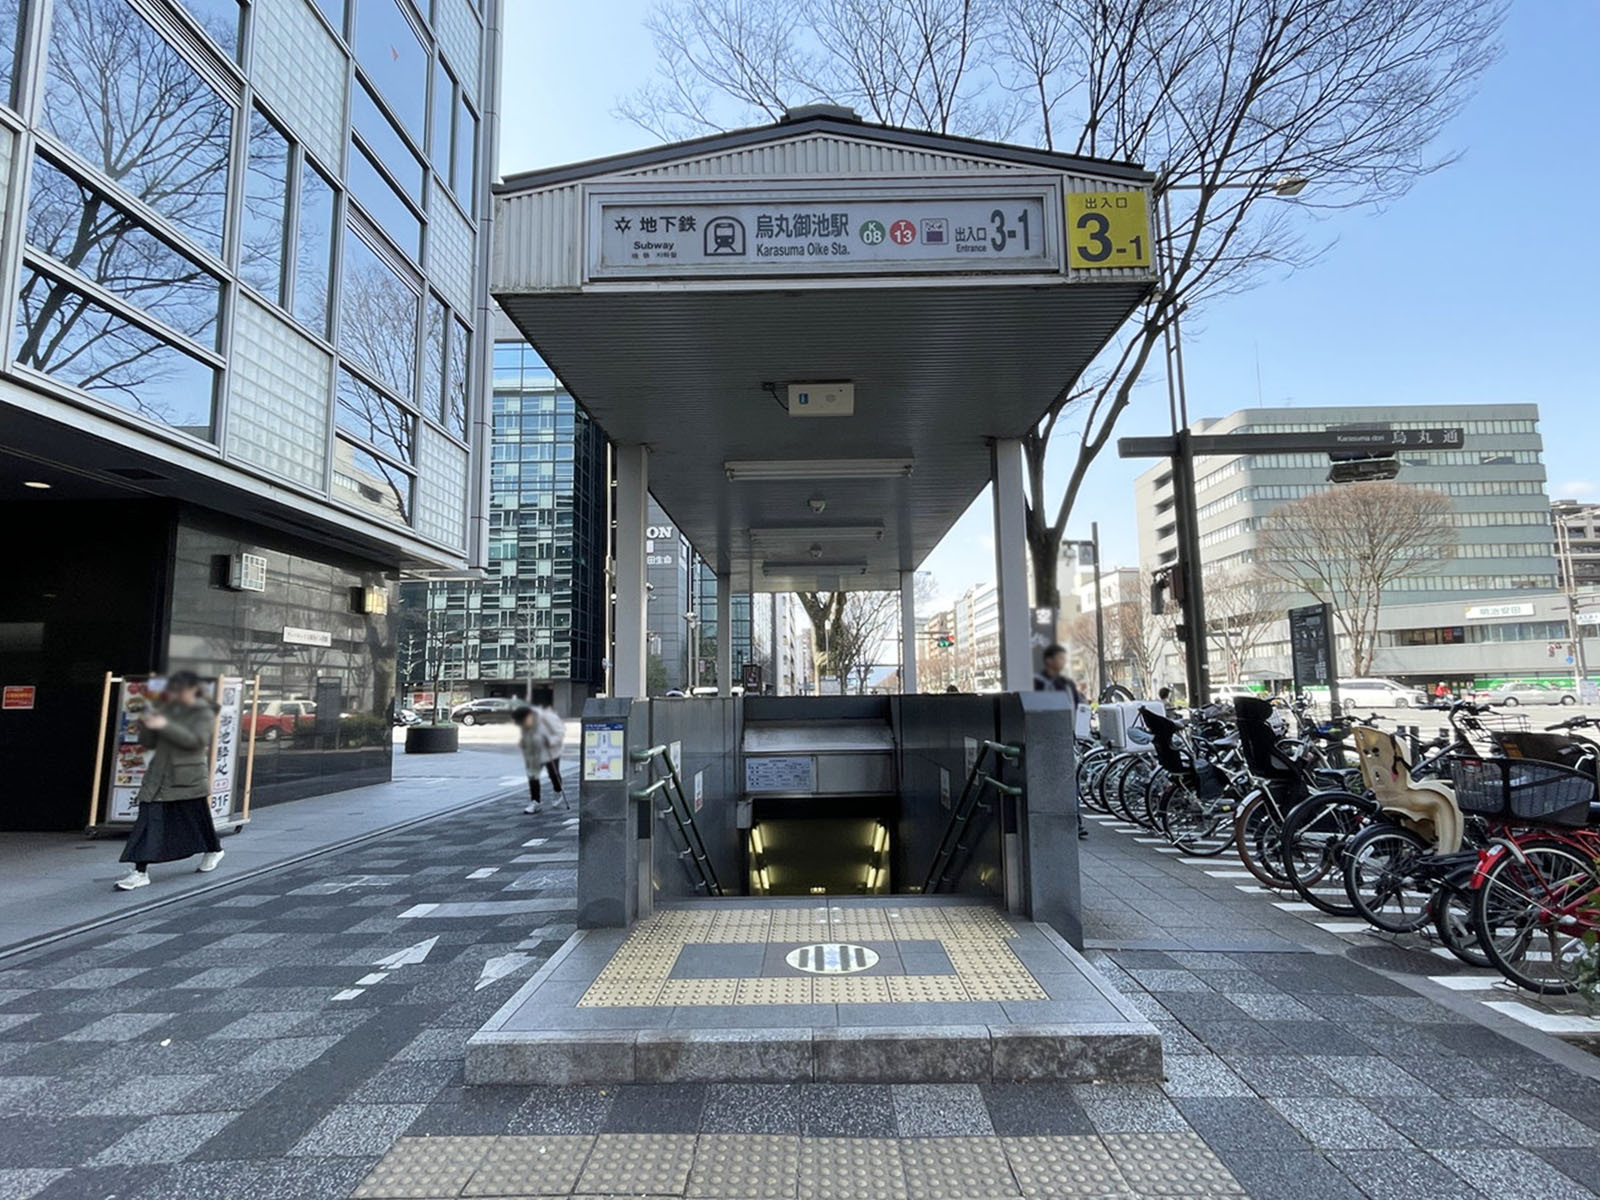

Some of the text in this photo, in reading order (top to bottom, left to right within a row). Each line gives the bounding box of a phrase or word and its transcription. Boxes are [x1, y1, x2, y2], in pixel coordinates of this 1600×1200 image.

[1085, 196, 1128, 209] 出入口
[640, 215, 697, 233] 地下鉄
[755, 213, 849, 239] 烏丸御池駅
[868, 222, 876, 230] K
[899, 222, 906, 230] T
[990, 209, 1030, 251] 3-1
[863, 231, 882, 243] 08
[894, 231, 912, 243] 13
[955, 227, 987, 242] 出入口
[1076, 212, 1142, 262] 3-1
[633, 241, 675, 251] Subway
[756, 241, 850, 256] Karasuma Oike Sta.
[956, 244, 987, 253] Entrance
[646, 526, 673, 539] ON
